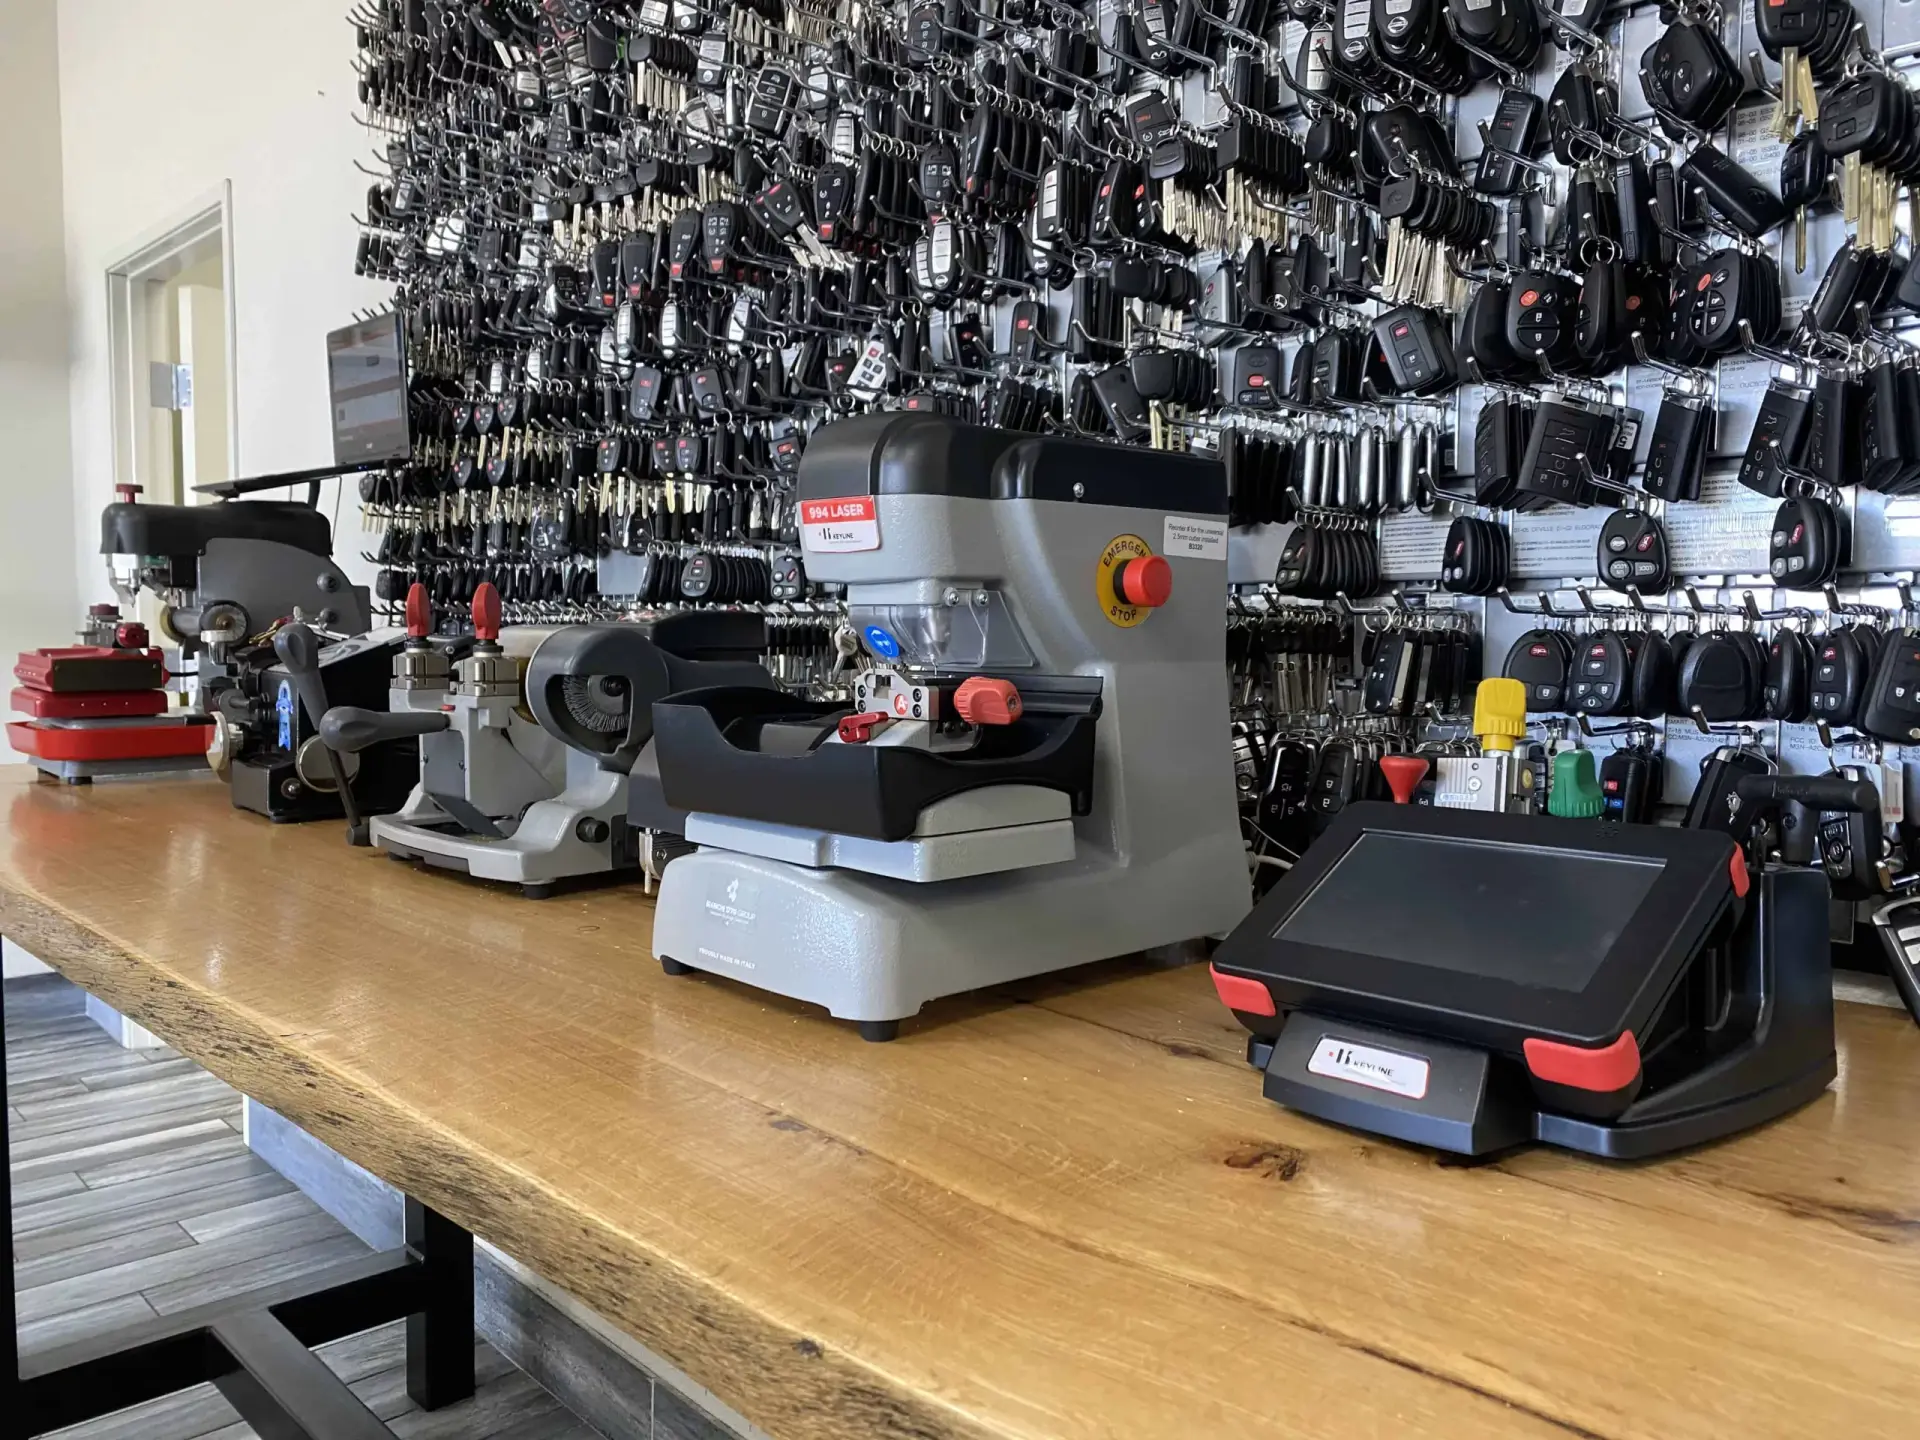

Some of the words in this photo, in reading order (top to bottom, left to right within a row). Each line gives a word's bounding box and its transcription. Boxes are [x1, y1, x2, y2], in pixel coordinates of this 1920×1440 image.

[809, 507, 829, 519] 994
[831, 503, 865, 518] LASER
[1168, 523, 1187, 532] Reorder
[1172, 532, 1188, 540] 2.5mm
[1188, 534, 1201, 542] cutter
[1103, 540, 1147, 567] EMERGEN
[1111, 605, 1137, 622] STOP
[738, 909, 757, 920] GROUP
[699, 947, 719, 959] PROUDLY
[719, 953, 733, 964] MADE
[740, 960, 756, 970] ITALY
[1353, 1060, 1395, 1077] KEYLINE
